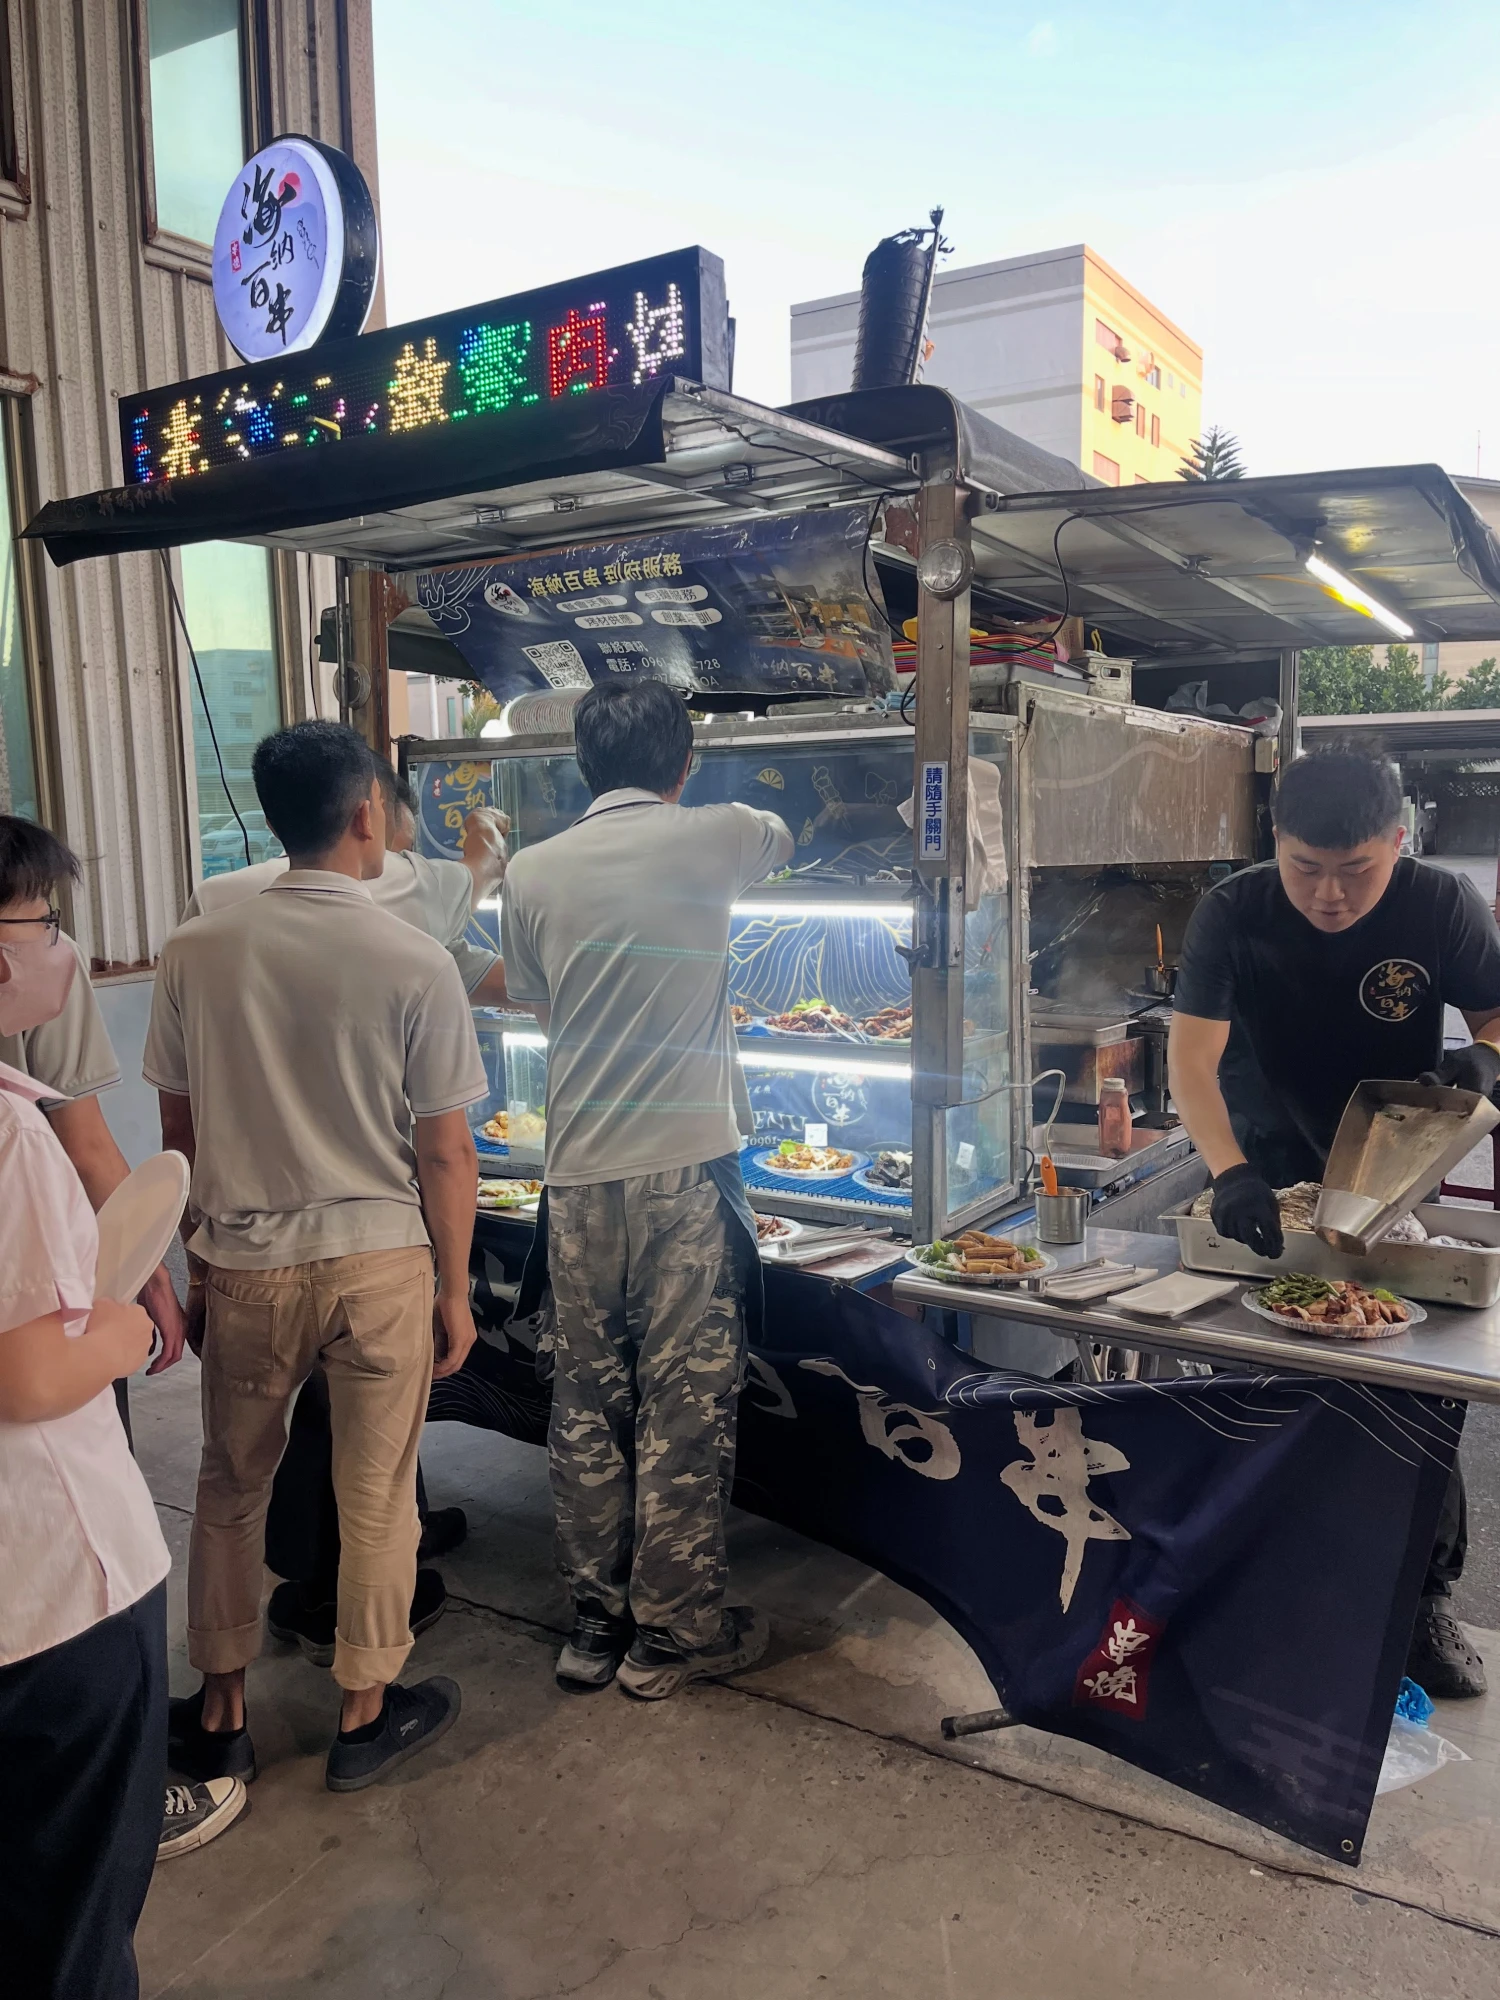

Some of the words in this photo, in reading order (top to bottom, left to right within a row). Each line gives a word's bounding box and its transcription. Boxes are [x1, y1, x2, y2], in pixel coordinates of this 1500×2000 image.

[527, 566, 602, 598] 海納百串
[604, 551, 684, 585] 到府服務
[925, 767, 943, 852] 請隨手關門
[753, 1110, 809, 1132] ENU
[1083, 1618, 1150, 1704] 串燒
